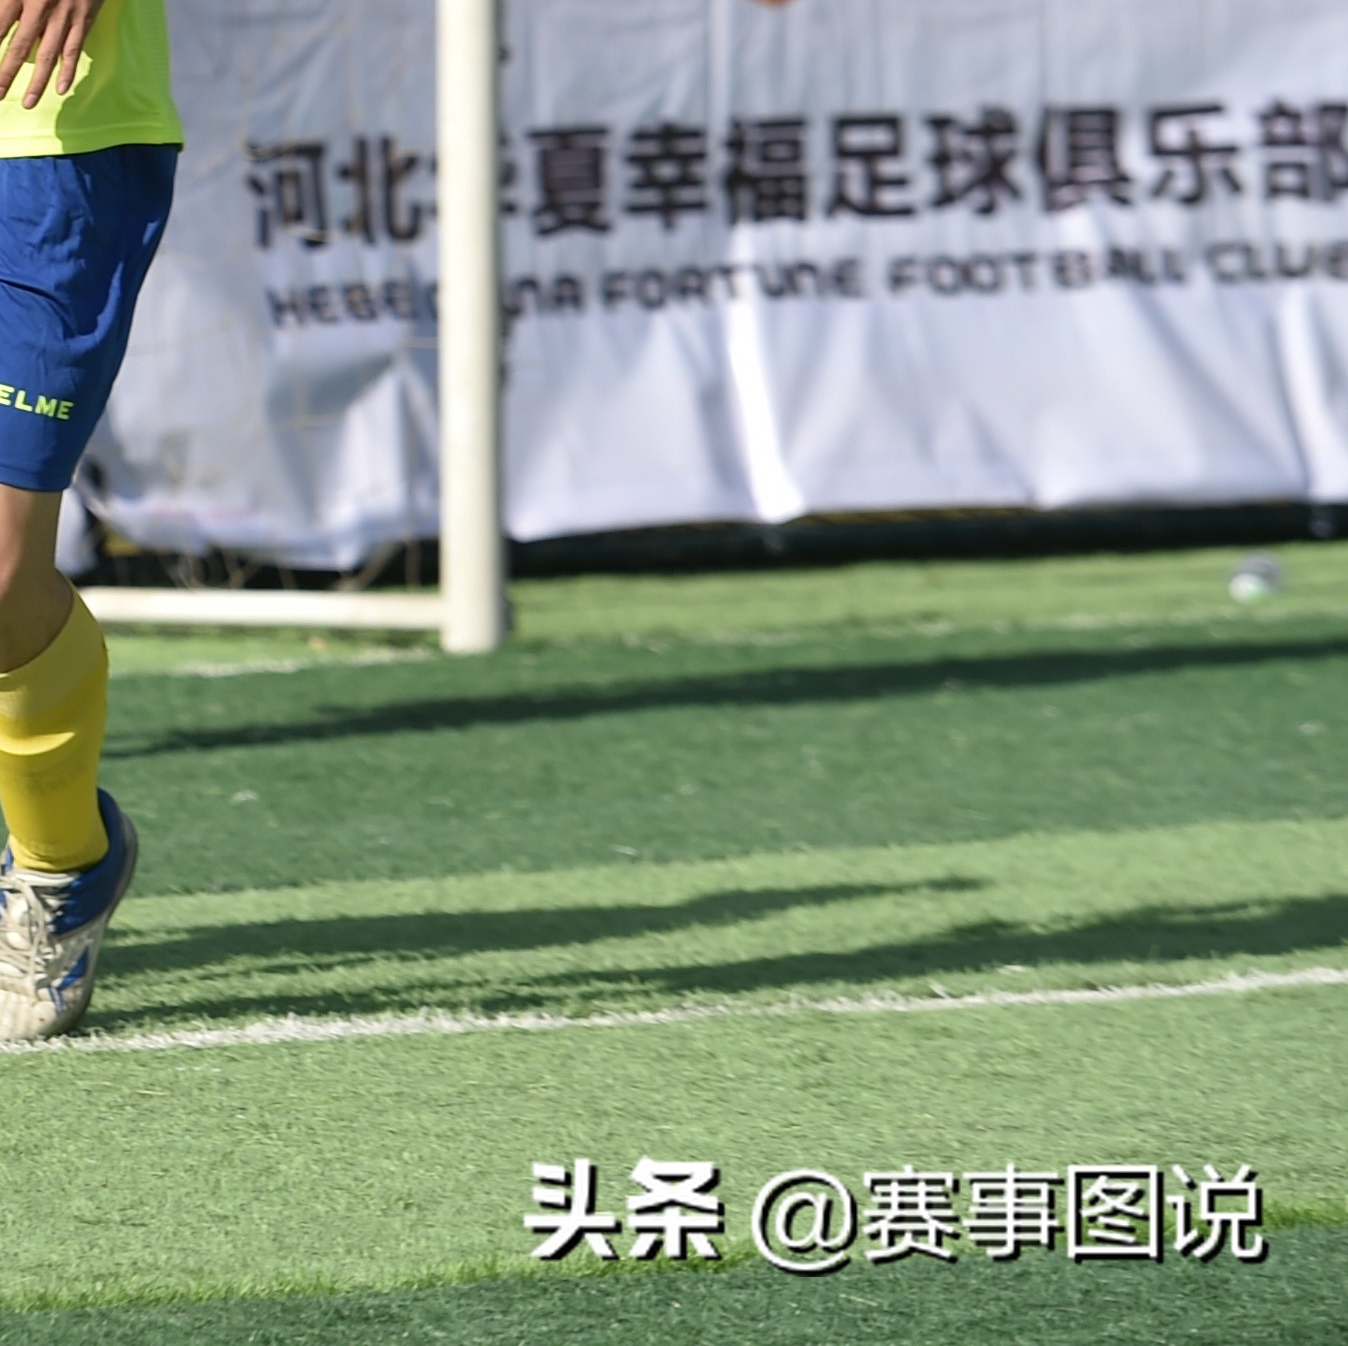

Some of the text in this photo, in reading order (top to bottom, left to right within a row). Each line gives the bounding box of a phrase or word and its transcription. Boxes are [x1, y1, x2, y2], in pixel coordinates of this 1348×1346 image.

[245, 100, 1348, 250] 河北夏幸福足球俱乐部
[604, 258, 864, 312] FORTUNE
